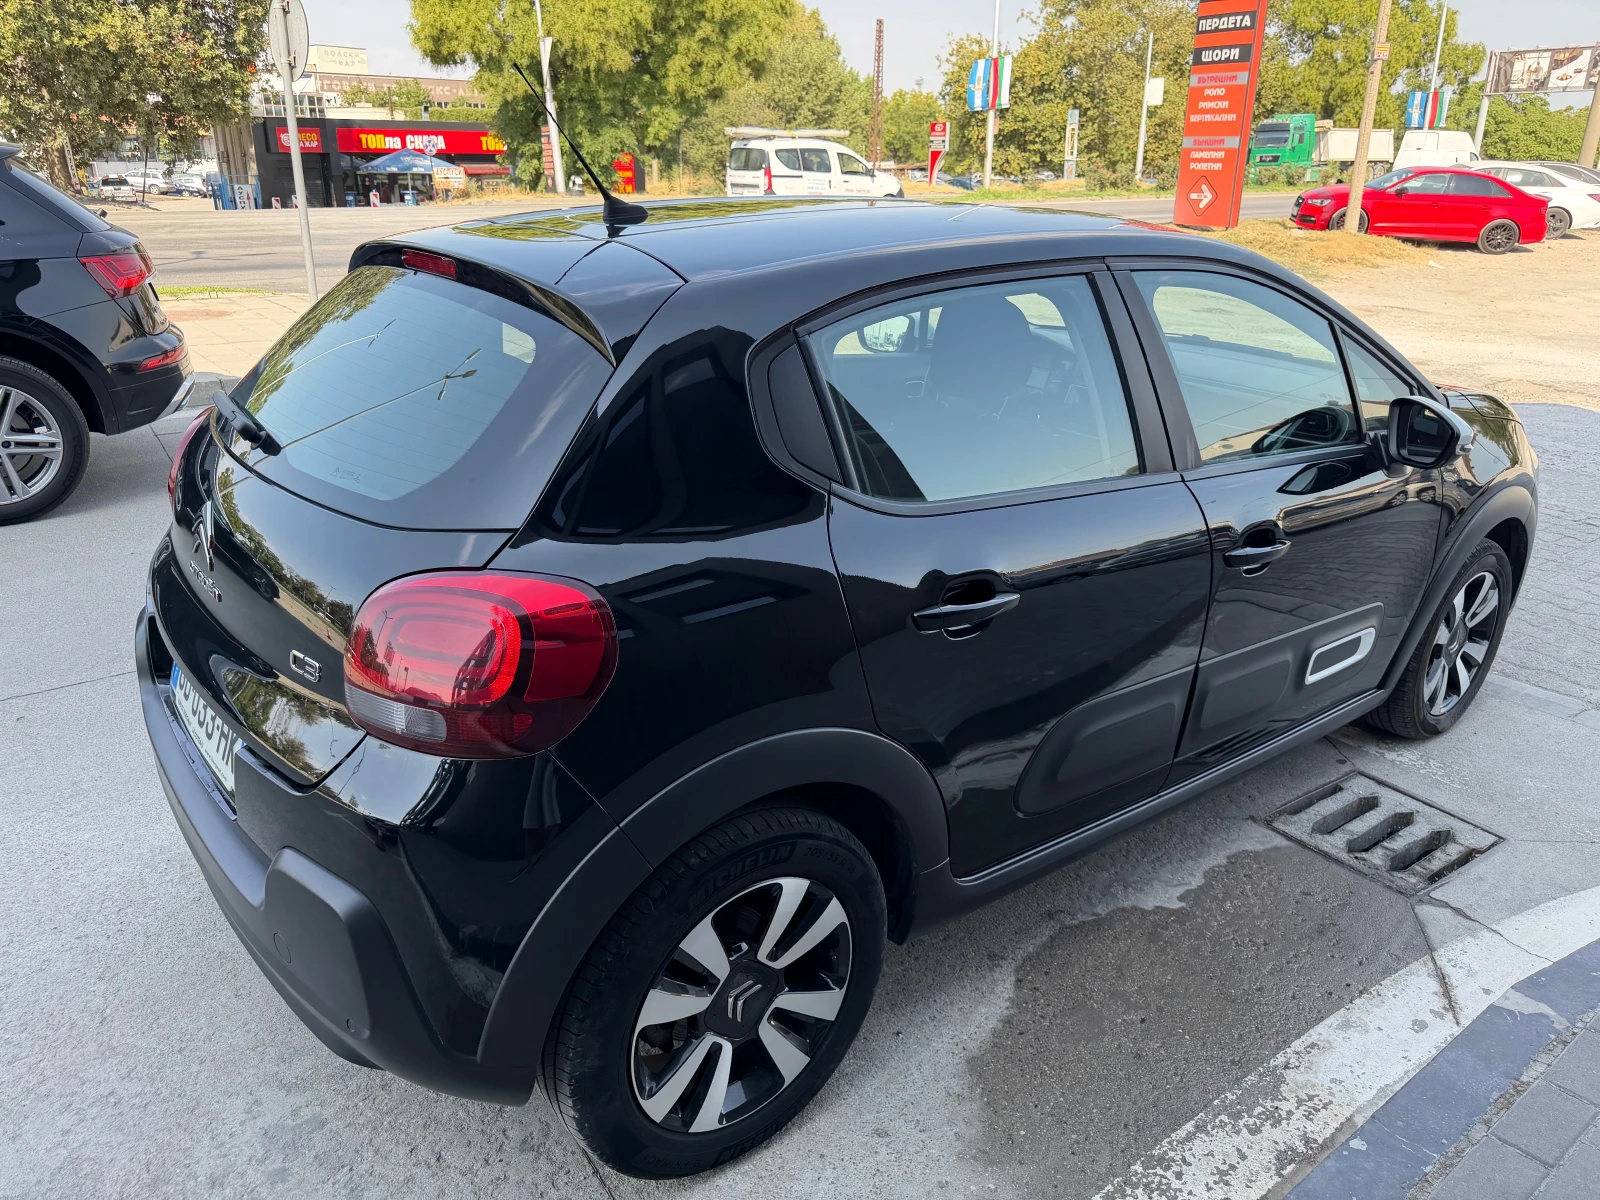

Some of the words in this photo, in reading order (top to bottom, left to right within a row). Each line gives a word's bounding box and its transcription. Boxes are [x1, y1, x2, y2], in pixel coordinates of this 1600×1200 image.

[1198, 14, 1251, 32] ПЕРДЕТА
[1197, 75, 1238, 84] ВЪТРЕШНИ
[1204, 88, 1226, 96] РОЛО
[1198, 101, 1229, 109] РИМСКИ
[1190, 114, 1237, 122] ВЕРТИКАЛНИ
[1190, 151, 1225, 159] ЛАМЕЛНИ
[1189, 162, 1222, 171] РОЛЕТНИ
[289, 649, 323, 683] C3
[803, 847, 840, 862] 205/55
[848, 862, 857, 875] 16
[686, 845, 792, 911] MICHELIN
